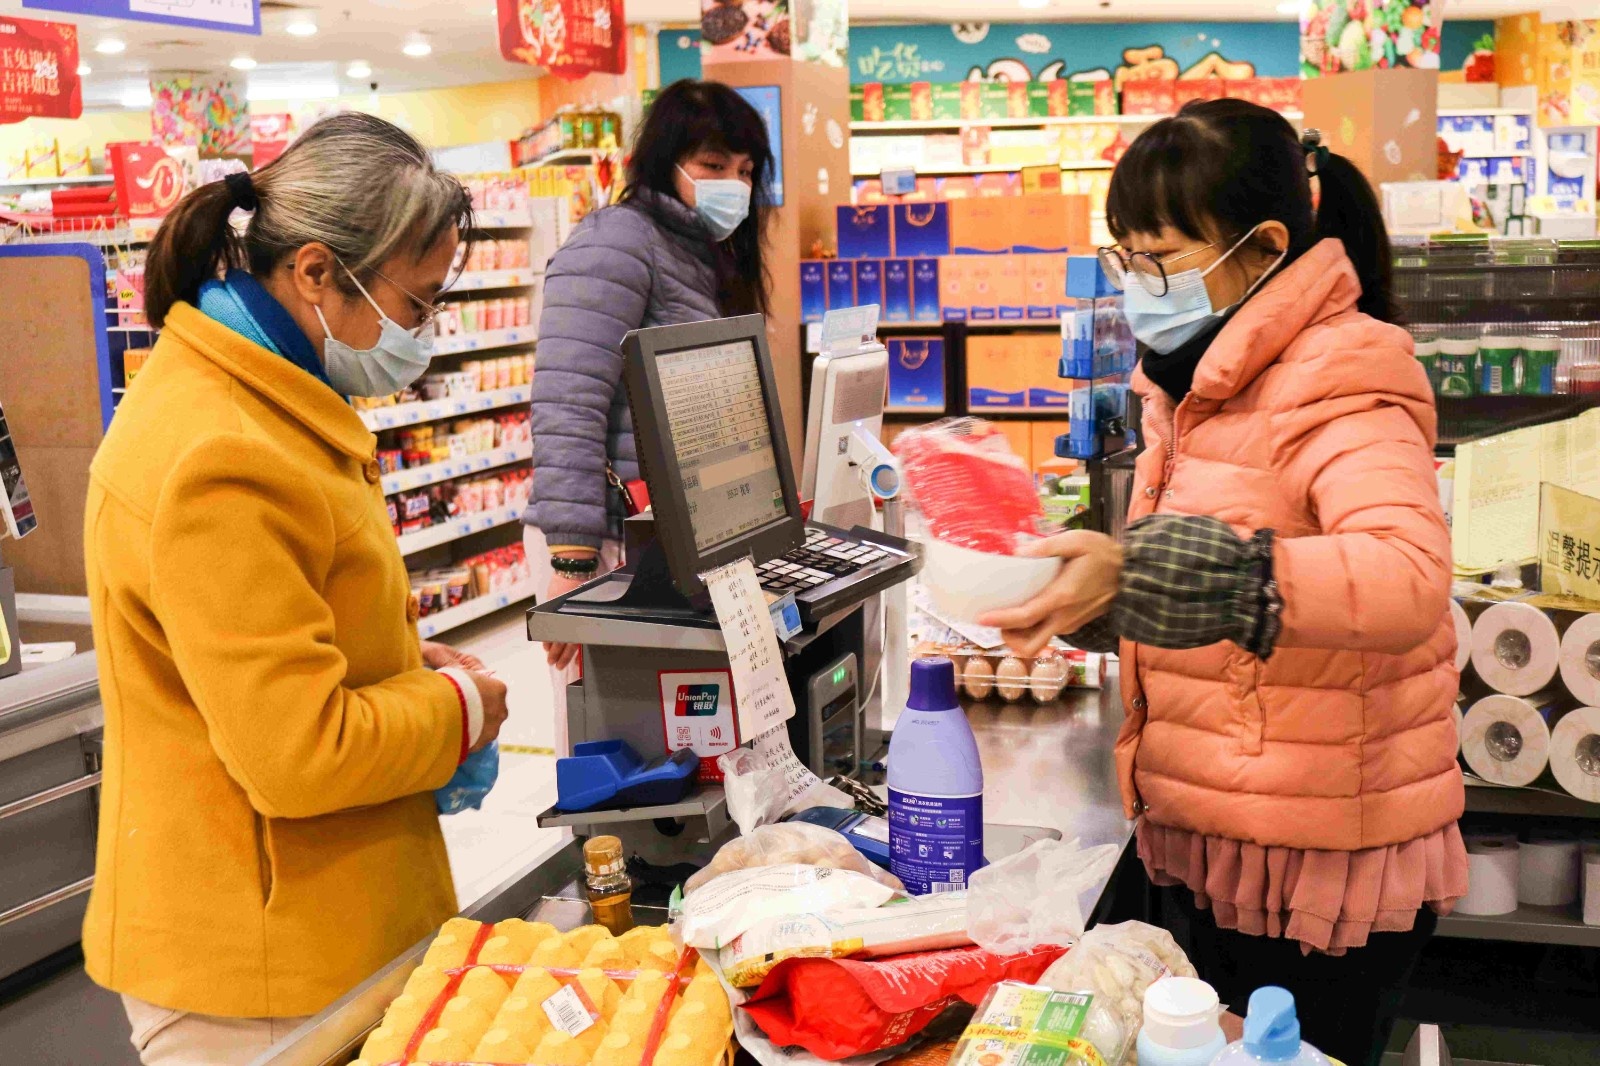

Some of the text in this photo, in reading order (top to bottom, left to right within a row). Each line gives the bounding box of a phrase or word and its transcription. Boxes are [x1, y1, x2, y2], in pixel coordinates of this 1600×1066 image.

[678, 692, 717, 703] UnionPay
[693, 702, 714, 711] 银联
[977, 1026, 1029, 1042] Special
